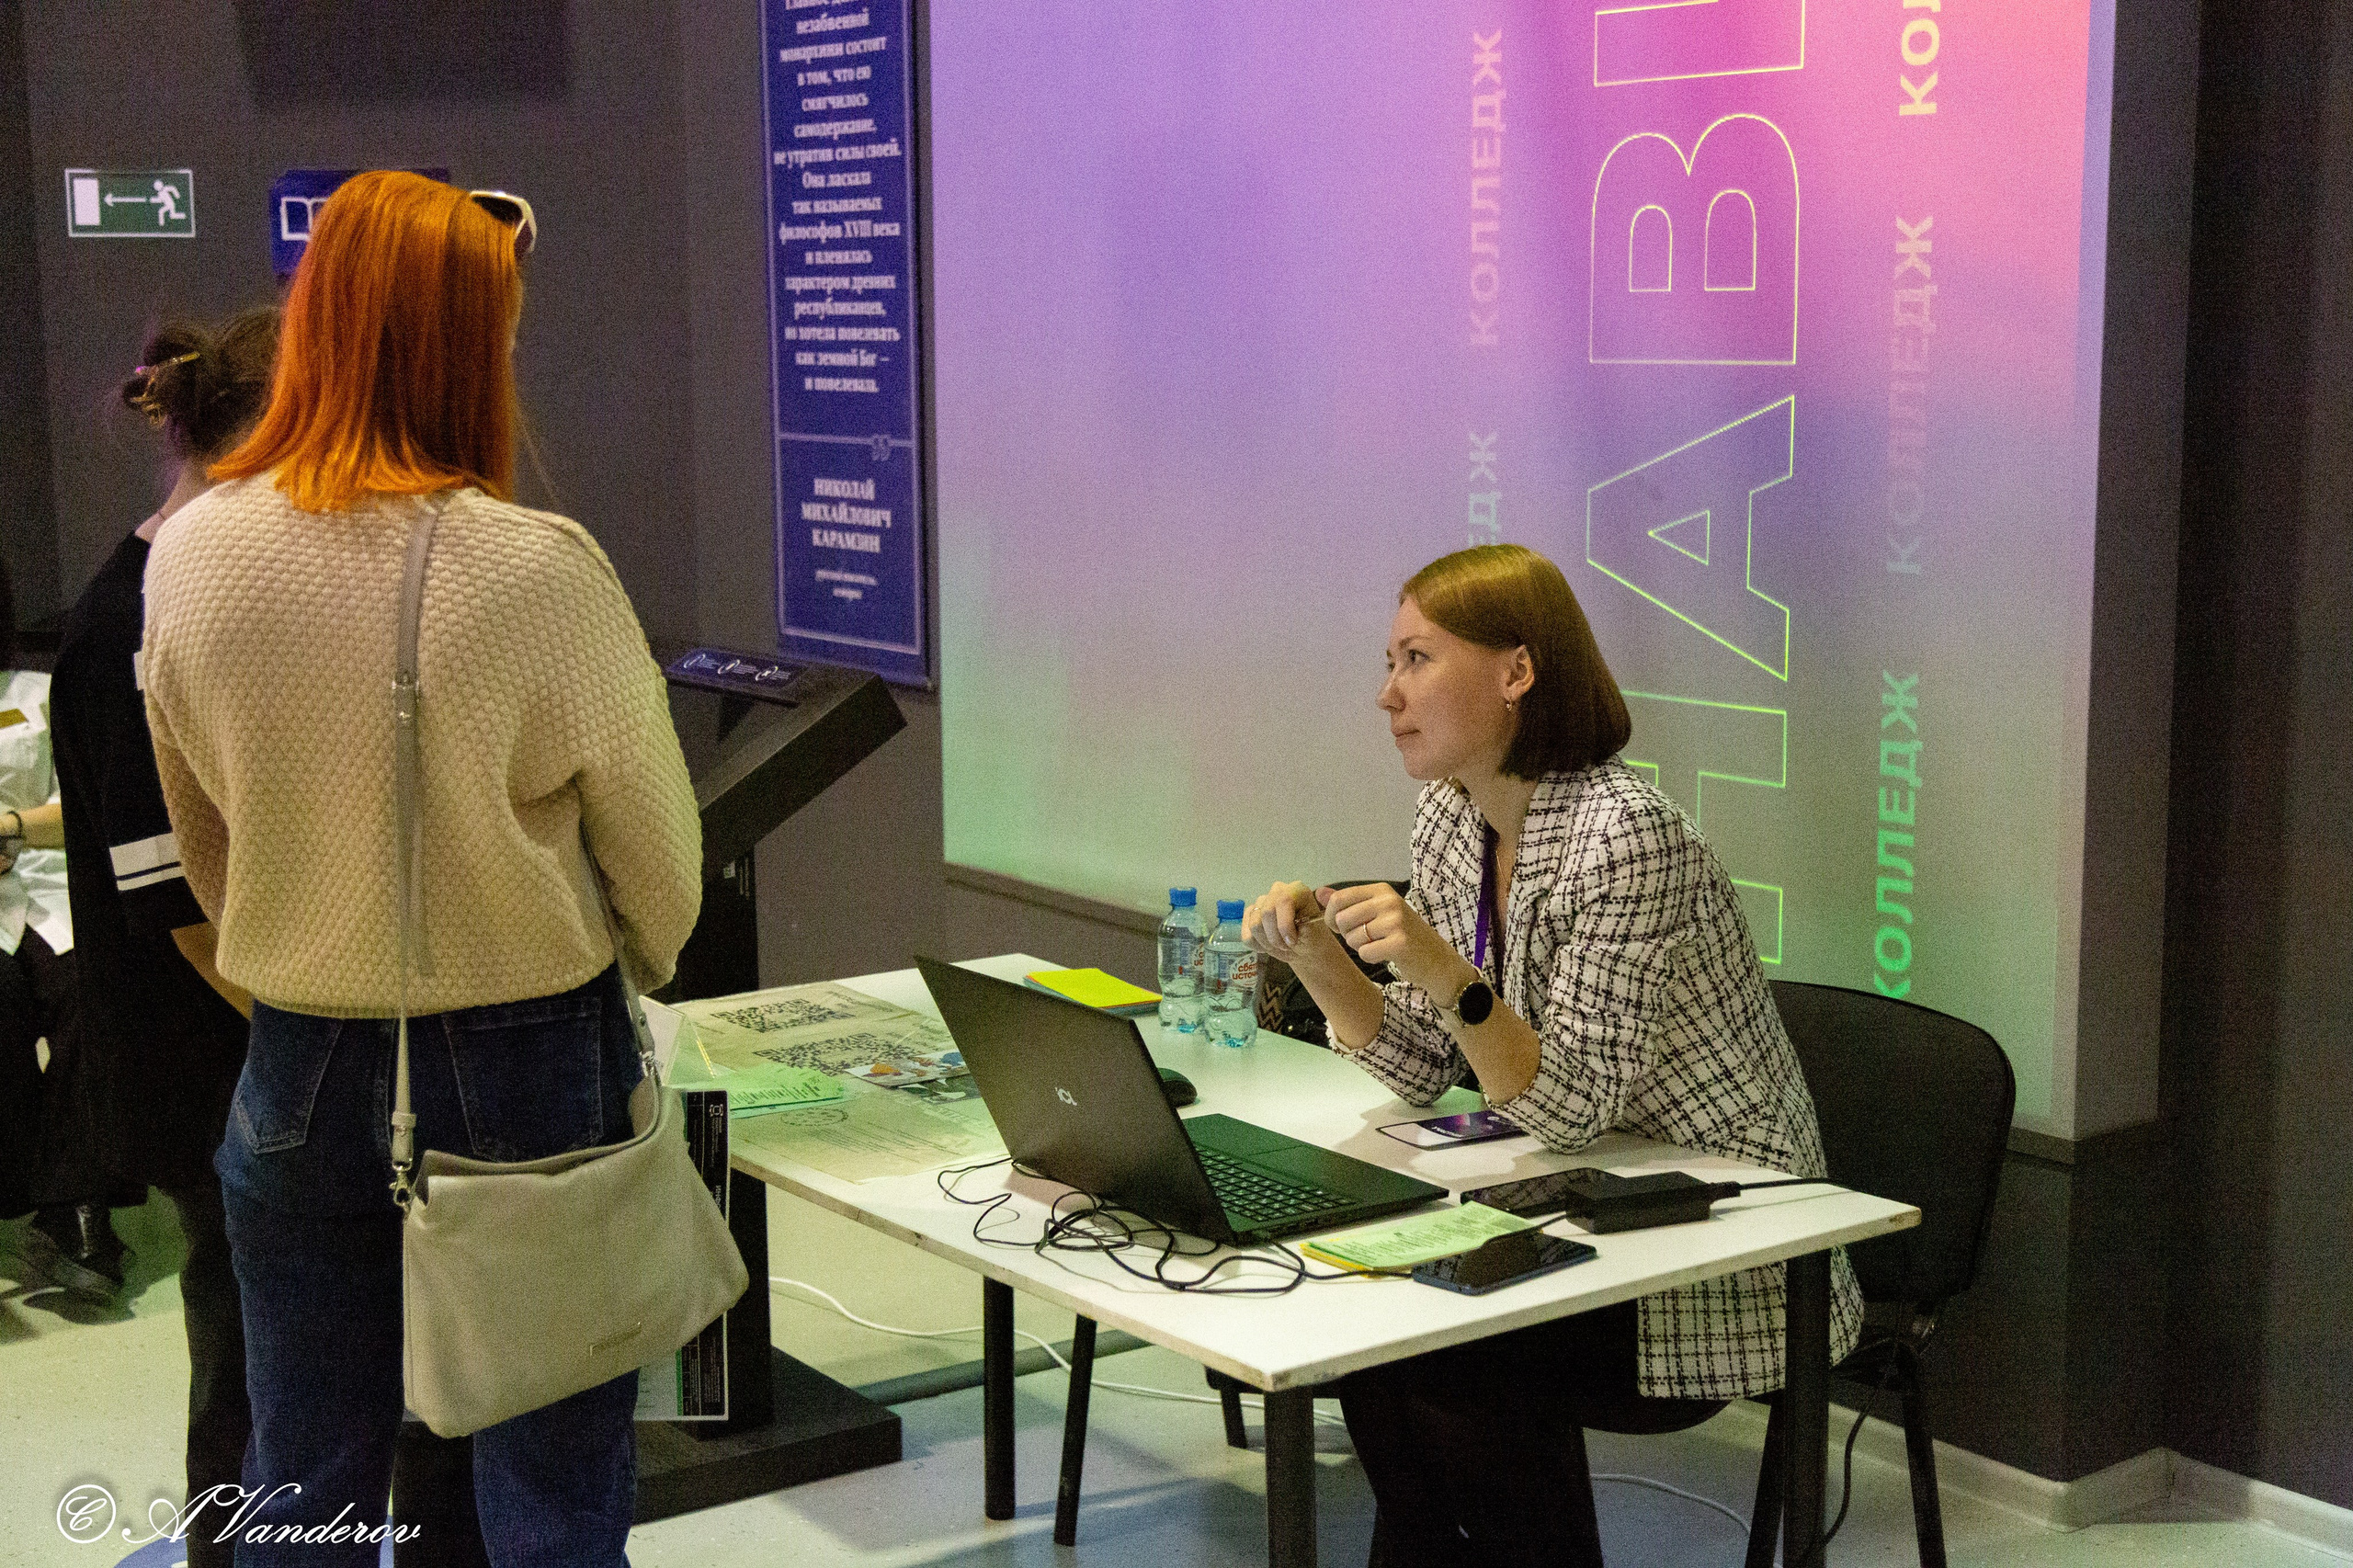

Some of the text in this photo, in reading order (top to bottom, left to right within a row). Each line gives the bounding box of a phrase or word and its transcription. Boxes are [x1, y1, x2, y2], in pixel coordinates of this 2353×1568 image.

[1471, 28, 1506, 347] КОЛЛЕДЖ
[813, 478, 875, 500] НИКОЛАЙ
[801, 502, 891, 528] МИХАЙЛОВИЧ
[812, 528, 881, 552] КАРАМЗИН
